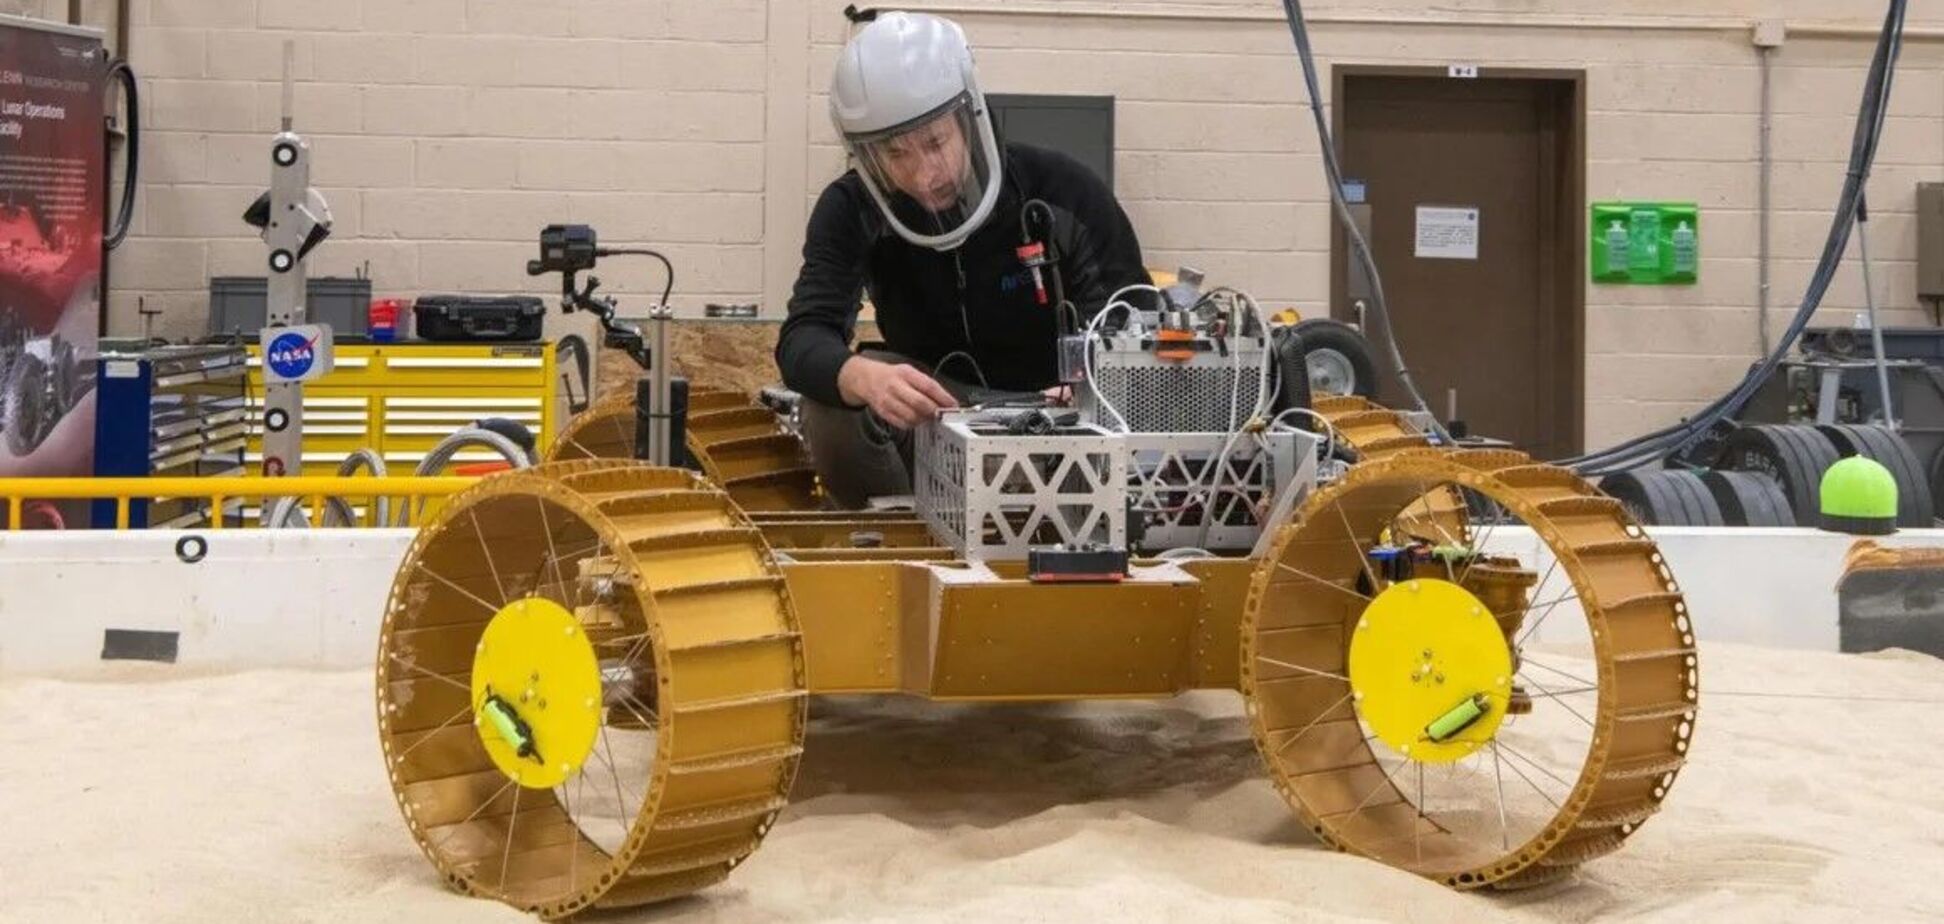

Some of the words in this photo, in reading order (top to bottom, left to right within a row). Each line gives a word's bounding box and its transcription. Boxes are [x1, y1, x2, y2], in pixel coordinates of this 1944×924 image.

[2, 99, 23, 115] Lunar
[24, 101, 65, 120] Operations
[271, 349, 311, 362] NASA
